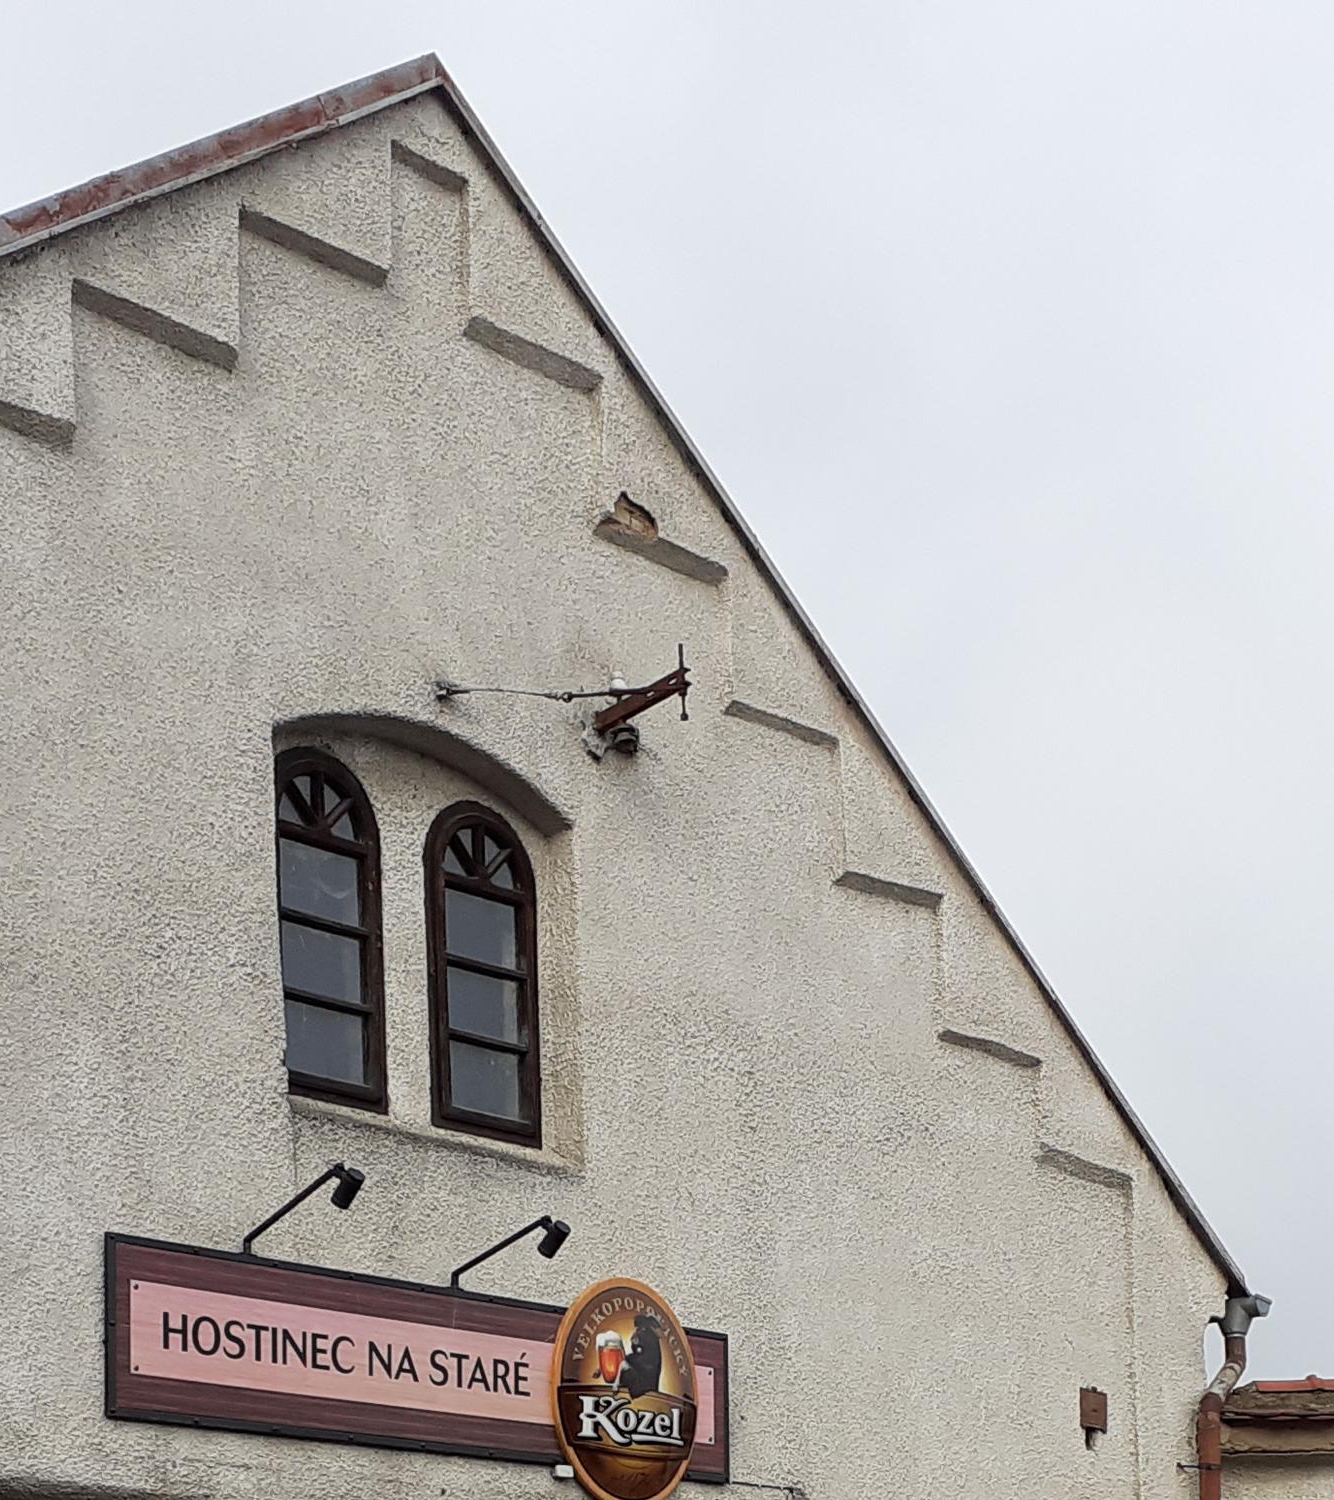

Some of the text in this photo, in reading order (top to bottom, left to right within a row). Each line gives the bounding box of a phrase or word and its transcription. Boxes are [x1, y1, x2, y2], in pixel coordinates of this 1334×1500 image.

[162, 1311, 531, 1397] HOSTINEC NA STARÉ
[576, 1395, 685, 1446] Kozel
